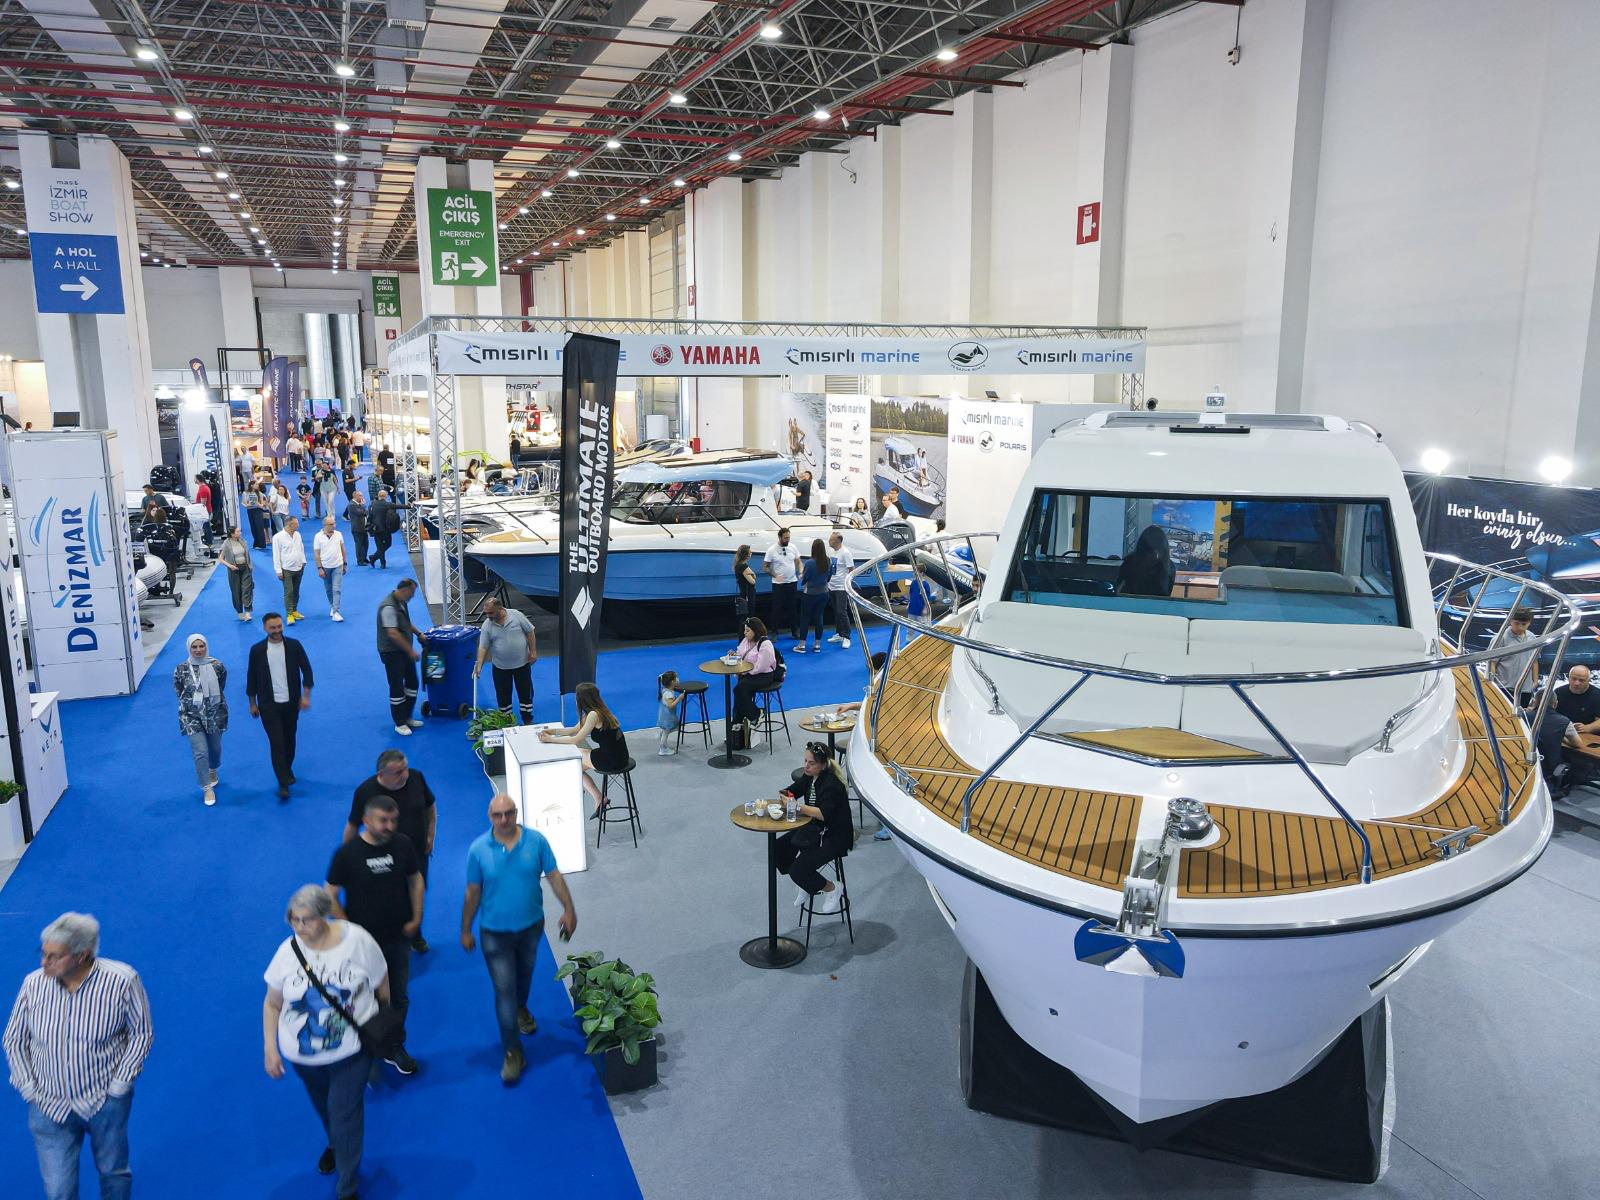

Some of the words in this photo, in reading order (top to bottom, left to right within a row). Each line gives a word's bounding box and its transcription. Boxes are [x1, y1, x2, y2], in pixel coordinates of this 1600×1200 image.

[50, 200, 88, 211] BOAT
[444, 194, 477, 209] ACİL
[49, 211, 94, 223] SHOW
[442, 210, 481, 226] ÇIKIŞ
[440, 230, 485, 239] EMERGENCY
[55, 246, 65, 257] A
[68, 247, 97, 258] HOL
[53, 260, 63, 270] A
[66, 260, 102, 271] HALL
[680, 345, 761, 365] YAMAHA
[861, 349, 920, 363] marine
[1081, 350, 1133, 363] marine
[594, 405, 611, 474] MOTOR
[999, 441, 1028, 451] POLARIS
[569, 542, 579, 574] THE
[578, 397, 600, 573] ULTIMATE
[1447, 503, 1472, 518] Her
[1473, 505, 1515, 525] koyda
[1517, 510, 1541, 527] bir
[588, 475, 607, 574] OUTBOARD
[1483, 524, 1524, 550] eviniz
[1525, 521, 1577, 546] olsun...
